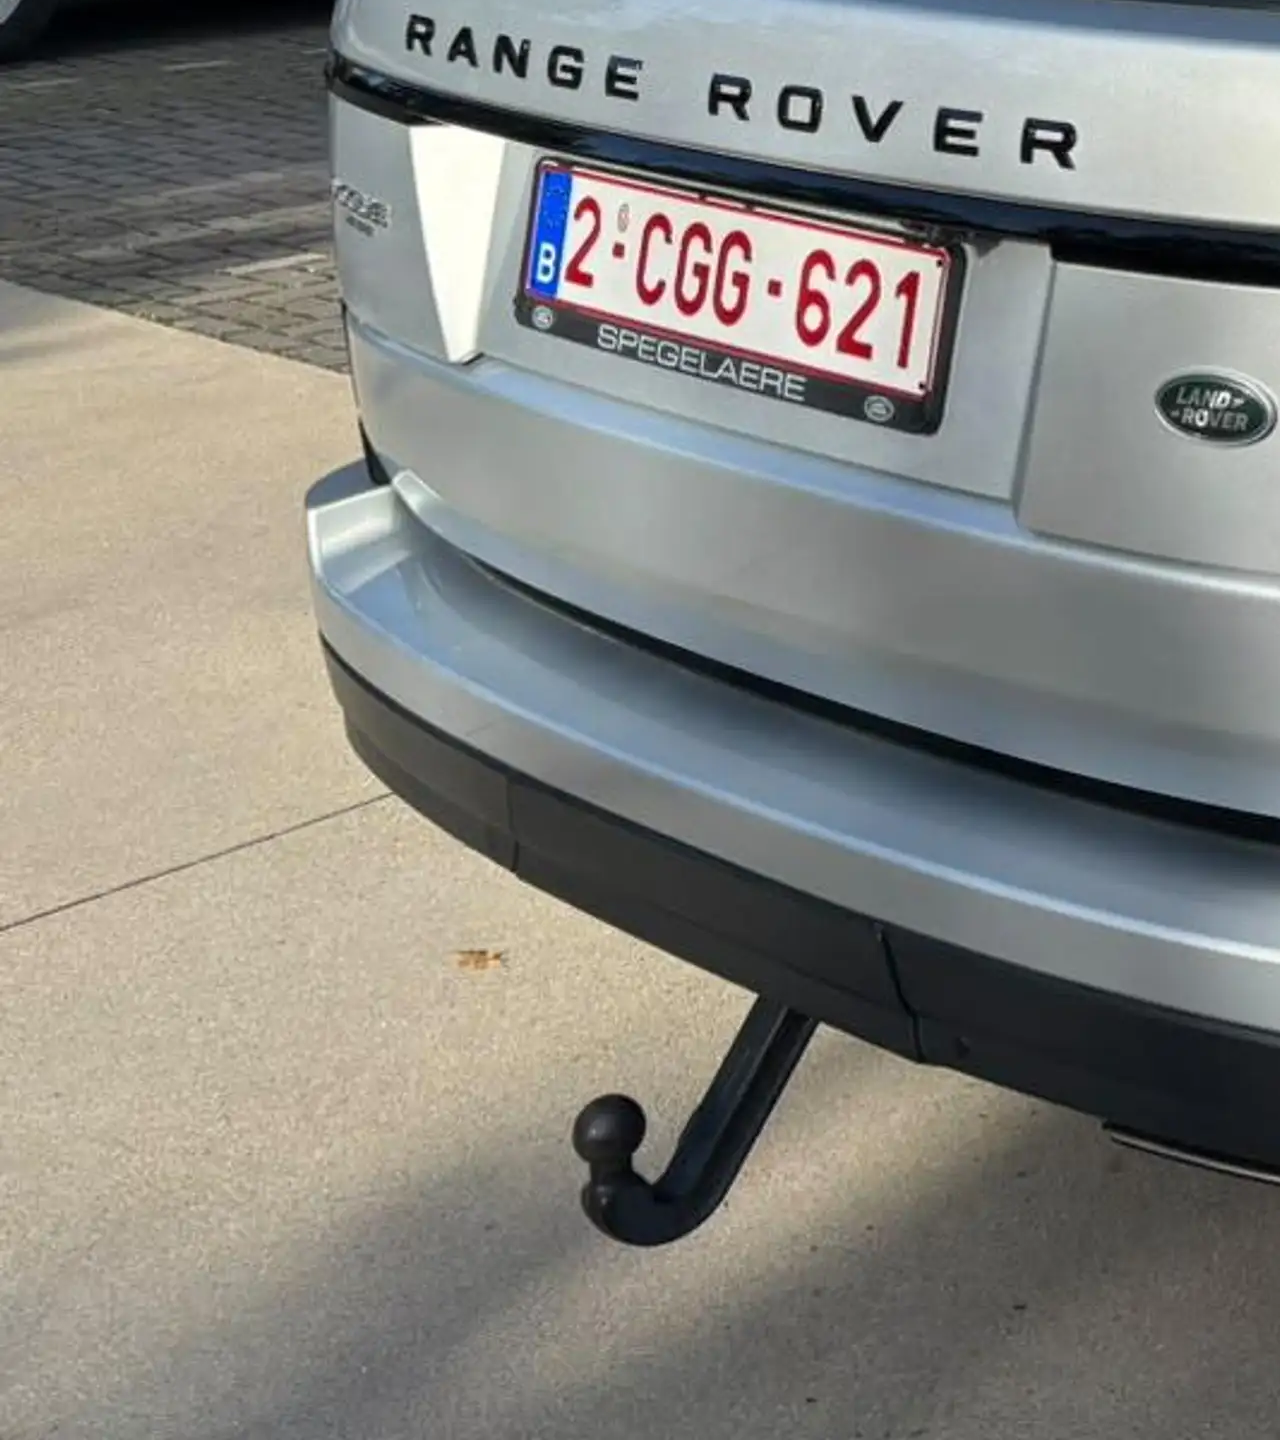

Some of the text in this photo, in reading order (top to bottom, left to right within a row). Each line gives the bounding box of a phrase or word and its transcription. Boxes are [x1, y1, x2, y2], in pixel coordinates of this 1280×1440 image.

[405, 13, 1079, 171] RANGE ROVER
[536, 195, 920, 369] B 2-CGG-621
[597, 324, 808, 402] SPEGELAERE
